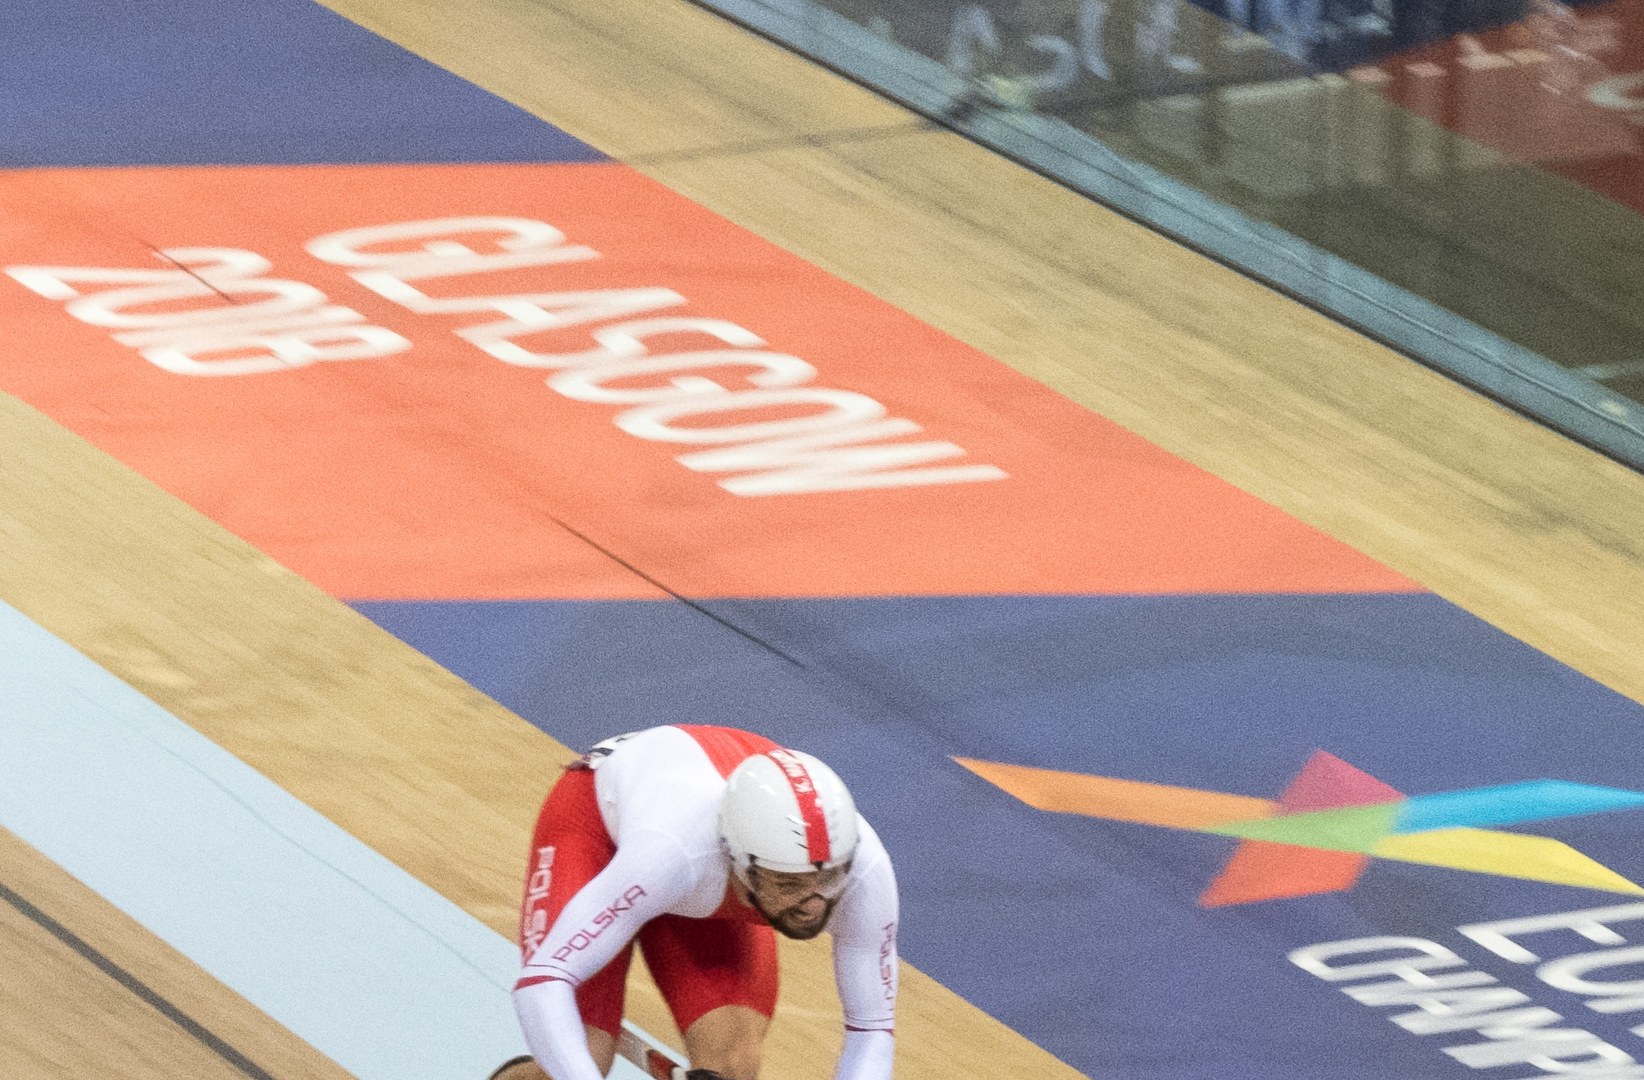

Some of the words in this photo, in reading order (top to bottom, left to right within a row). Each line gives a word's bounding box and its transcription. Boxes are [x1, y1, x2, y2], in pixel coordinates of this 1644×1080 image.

[2, 246, 414, 377] 2018
[303, 215, 1010, 498] GLASGOW
[551, 885, 648, 962] POLSKA
